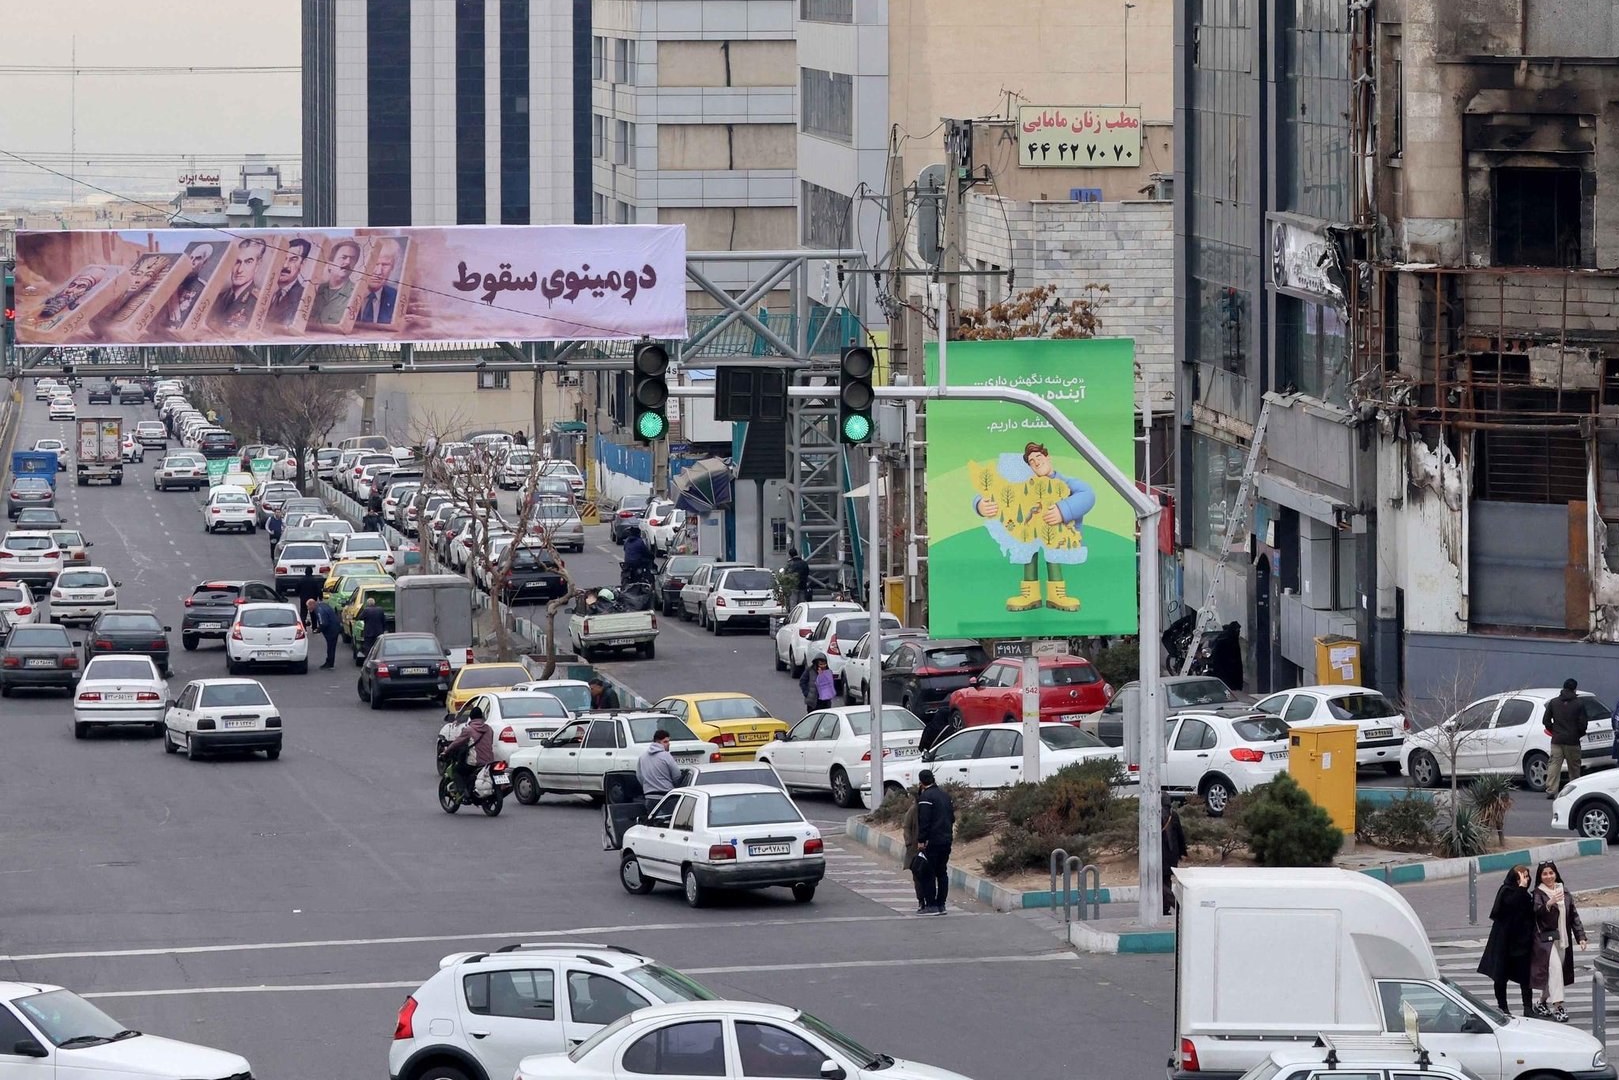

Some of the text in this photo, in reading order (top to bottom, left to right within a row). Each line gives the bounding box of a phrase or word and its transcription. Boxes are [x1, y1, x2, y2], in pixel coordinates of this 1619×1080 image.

[1022, 110, 1138, 133] مطب زنان مامایی
[453, 261, 657, 306] دومینوی سقوط
[1010, 373, 1042, 388] نگهش
[1047, 386, 1085, 402] آینده
